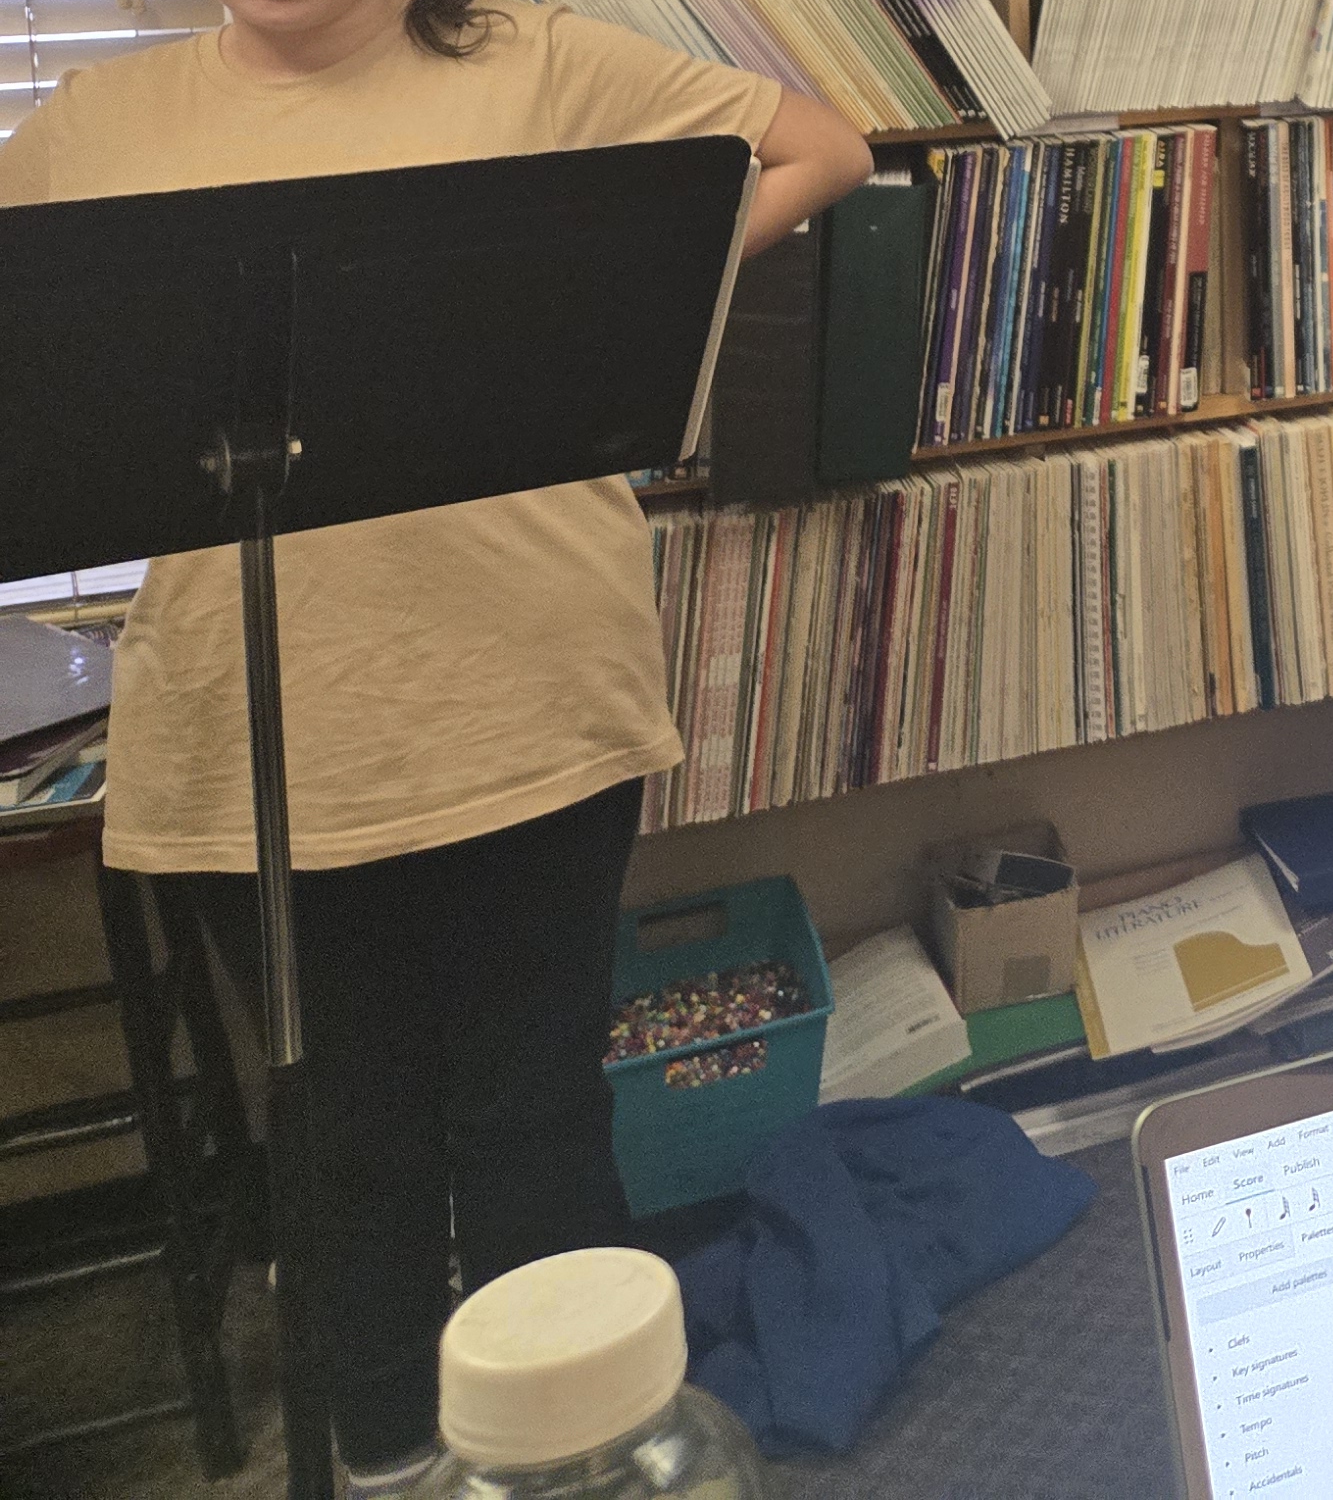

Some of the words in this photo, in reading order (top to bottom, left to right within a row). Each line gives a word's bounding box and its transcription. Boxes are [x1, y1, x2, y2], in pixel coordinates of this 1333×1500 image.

[1059, 147, 1076, 227] HAMILTON
[1174, 1164, 1190, 1176] File
[1202, 1155, 1221, 1168] Edit
[1233, 1146, 1255, 1159] View
[1267, 1136, 1286, 1149] Add
[1299, 1124, 1330, 1140] Format
[1181, 1188, 1215, 1206] Home
[1233, 1173, 1265, 1190] Score
[1283, 1156, 1321, 1176] Publish
[1190, 1260, 1222, 1278] Layout
[1239, 1241, 1286, 1263] Properties
[1272, 1281, 1291, 1294] Add
[1293, 1269, 1328, 1290] palettes
[1227, 1334, 1251, 1350] Clefs
[1232, 1365, 1250, 1379] Key
[1251, 1349, 1299, 1372] signatures
[1236, 1391, 1261, 1406] Time
[1262, 1374, 1310, 1398] signatures
[1240, 1417, 1273, 1434] Tempo
[1244, 1446, 1270, 1463] Pitch
[1249, 1465, 1304, 1492] Accidentals
